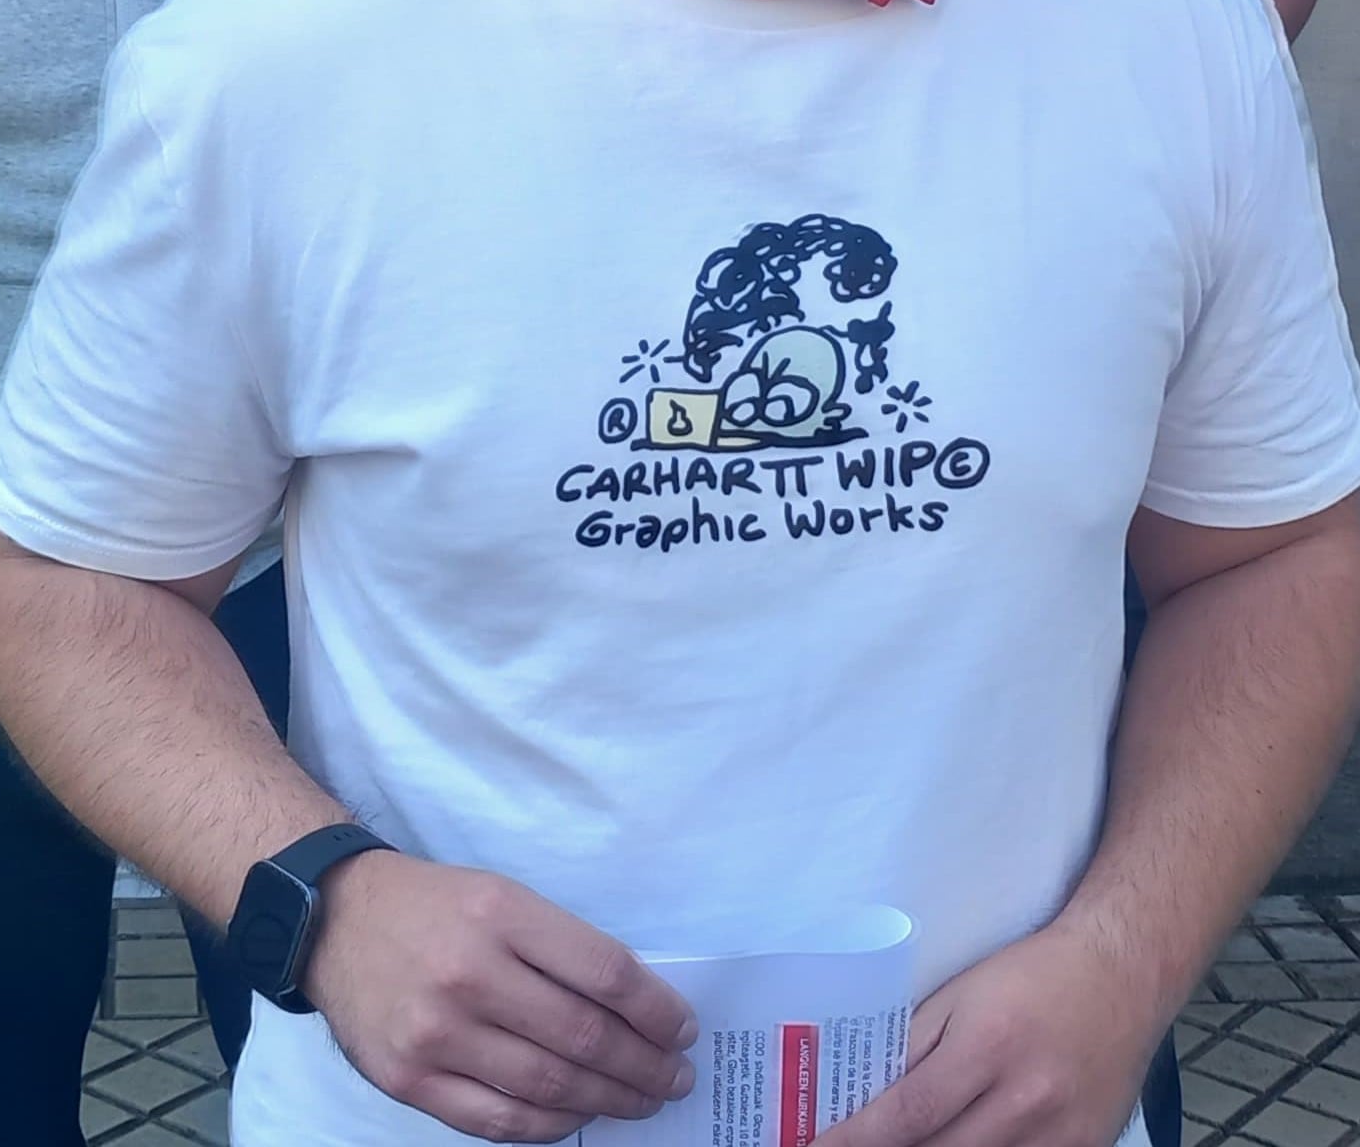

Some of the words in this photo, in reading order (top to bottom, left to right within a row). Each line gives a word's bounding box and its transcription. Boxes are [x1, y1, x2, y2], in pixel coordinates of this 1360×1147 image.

[556, 456, 824, 502] CARHARTT
[576, 496, 766, 552] Graphic
[784, 492, 949, 539] Works
